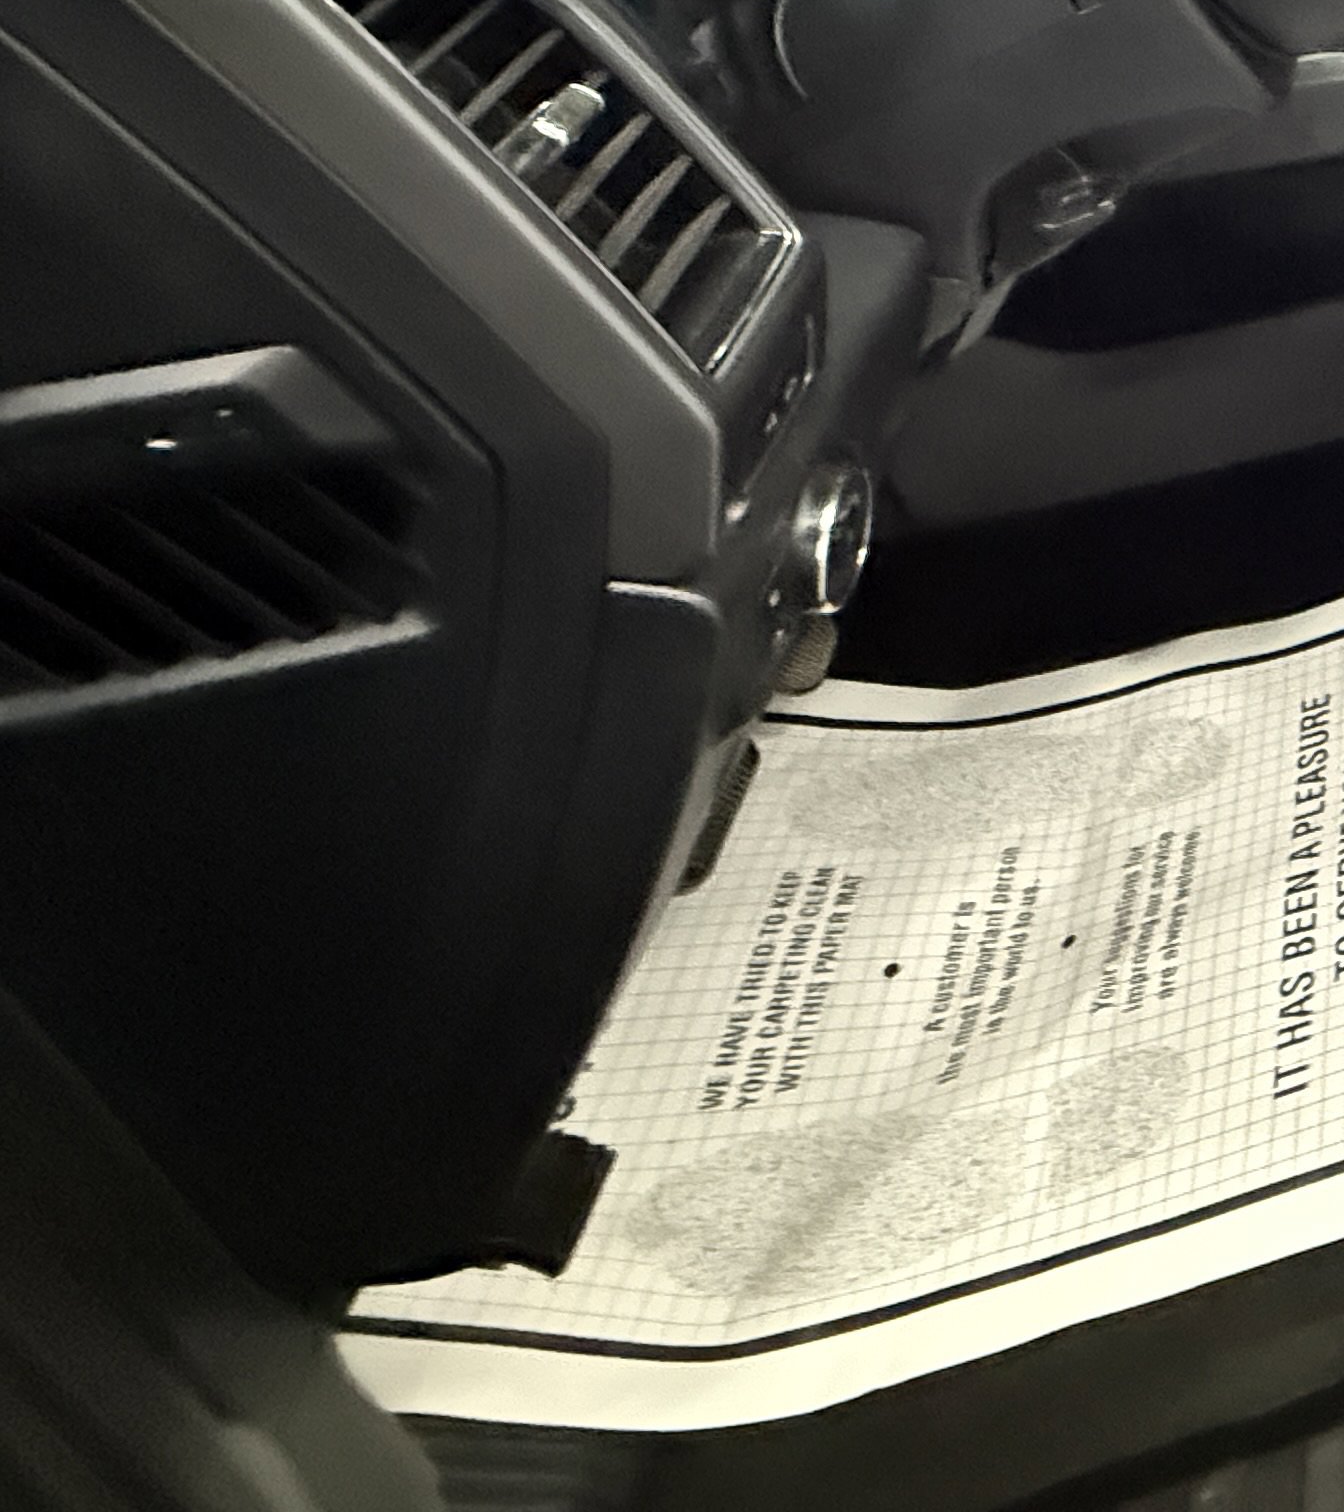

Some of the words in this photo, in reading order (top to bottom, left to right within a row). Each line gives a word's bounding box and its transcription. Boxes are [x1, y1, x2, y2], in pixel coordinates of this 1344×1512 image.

[1291, 692, 1332, 836] PLEASURE
[1150, 831, 1175, 887] service
[1288, 839, 1320, 860] A
[768, 871, 801, 907] KEEP
[1020, 878, 1040, 905] us.
[758, 913, 787, 936] TO
[1011, 911, 1034, 927] to
[1158, 903, 1188, 959] always
[1280, 870, 1319, 960] BEEN
[735, 942, 775, 1002] TRIED
[931, 922, 969, 1012] customer
[936, 1052, 966, 1083] the
[952, 1002, 981, 1046] most
[967, 909, 1005, 996] important
[991, 846, 1020, 902] person
[1002, 932, 1028, 979] world
[732, 1046, 776, 1109] YOUR
[755, 923, 816, 1037] CARPETING
[798, 867, 835, 916] CLEAN
[775, 1036, 813, 1091] WITH
[795, 981, 829, 1026] THIS
[812, 911, 851, 973] PAPER
[833, 873, 863, 905] MAT
[988, 985, 1015, 1013] the
[1089, 968, 1117, 1013] Your
[1157, 966, 1178, 998] are
[923, 1018, 945, 1031] A
[1276, 970, 1315, 1049] HAS
[712, 1011, 754, 1066] HAVE
[698, 1075, 732, 1109] WE
[1273, 1060, 1311, 1098] IT
